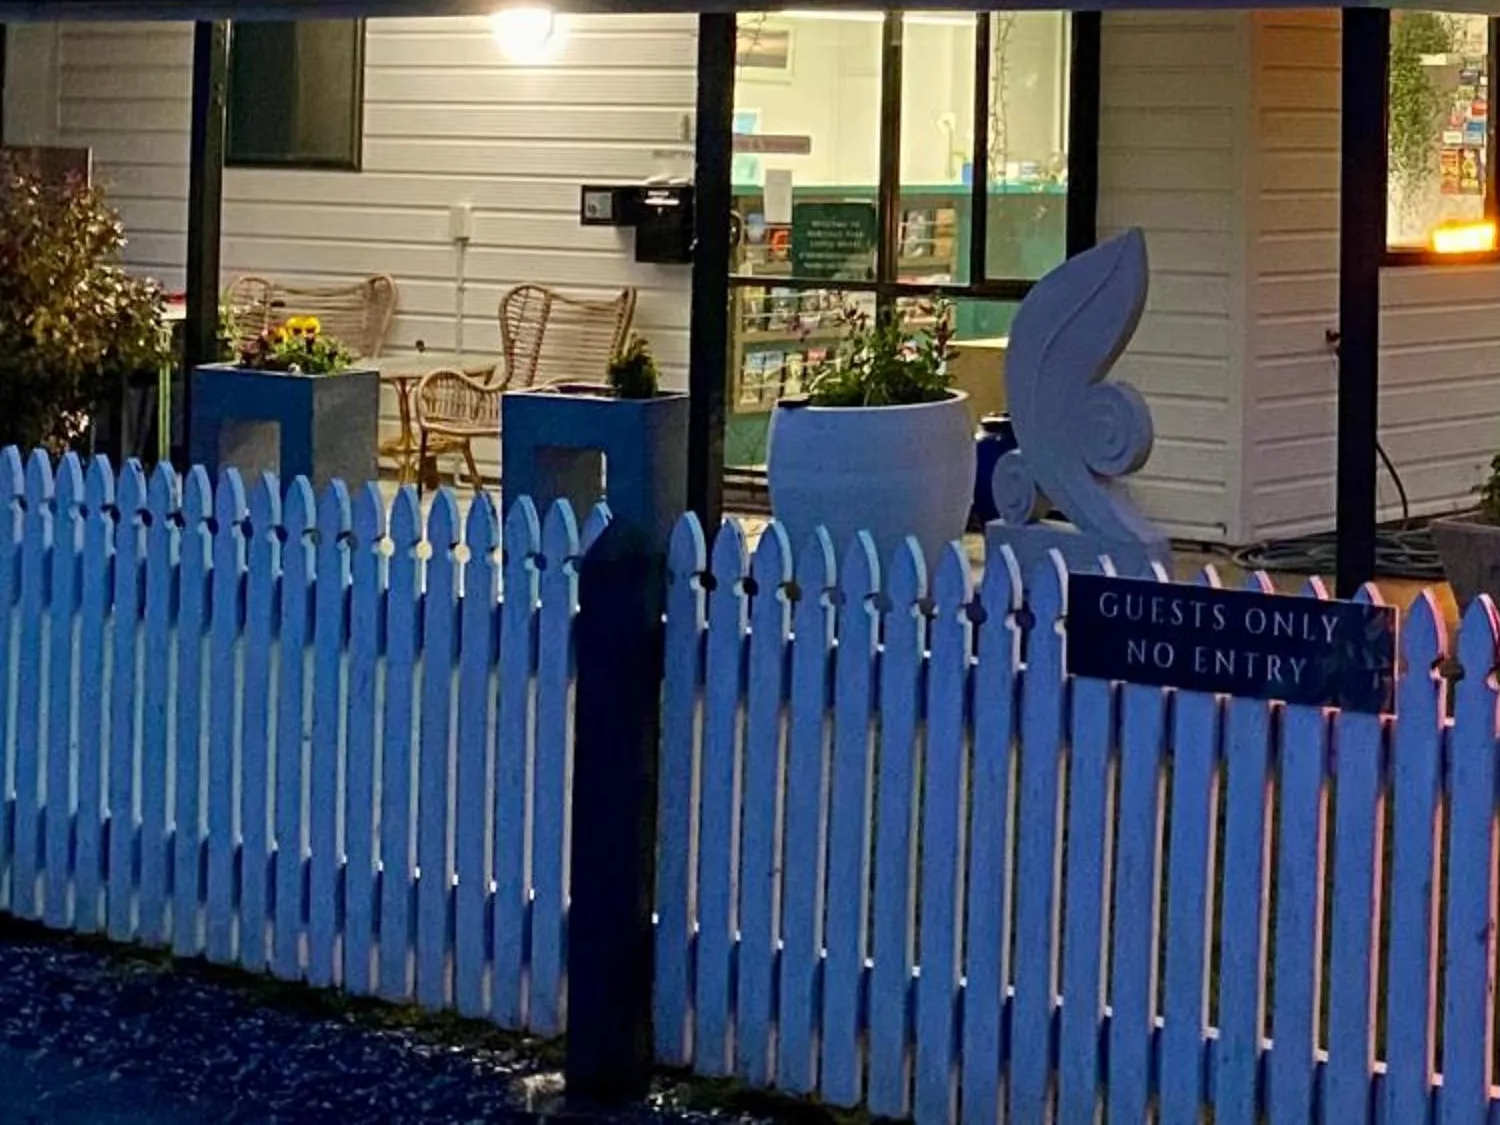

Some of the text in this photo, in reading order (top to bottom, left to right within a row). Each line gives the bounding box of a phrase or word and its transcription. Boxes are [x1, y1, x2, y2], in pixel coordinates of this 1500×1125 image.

[1099, 591, 1339, 643] GUESTS ONLY
[1127, 639, 1308, 683] NO ENTRY
